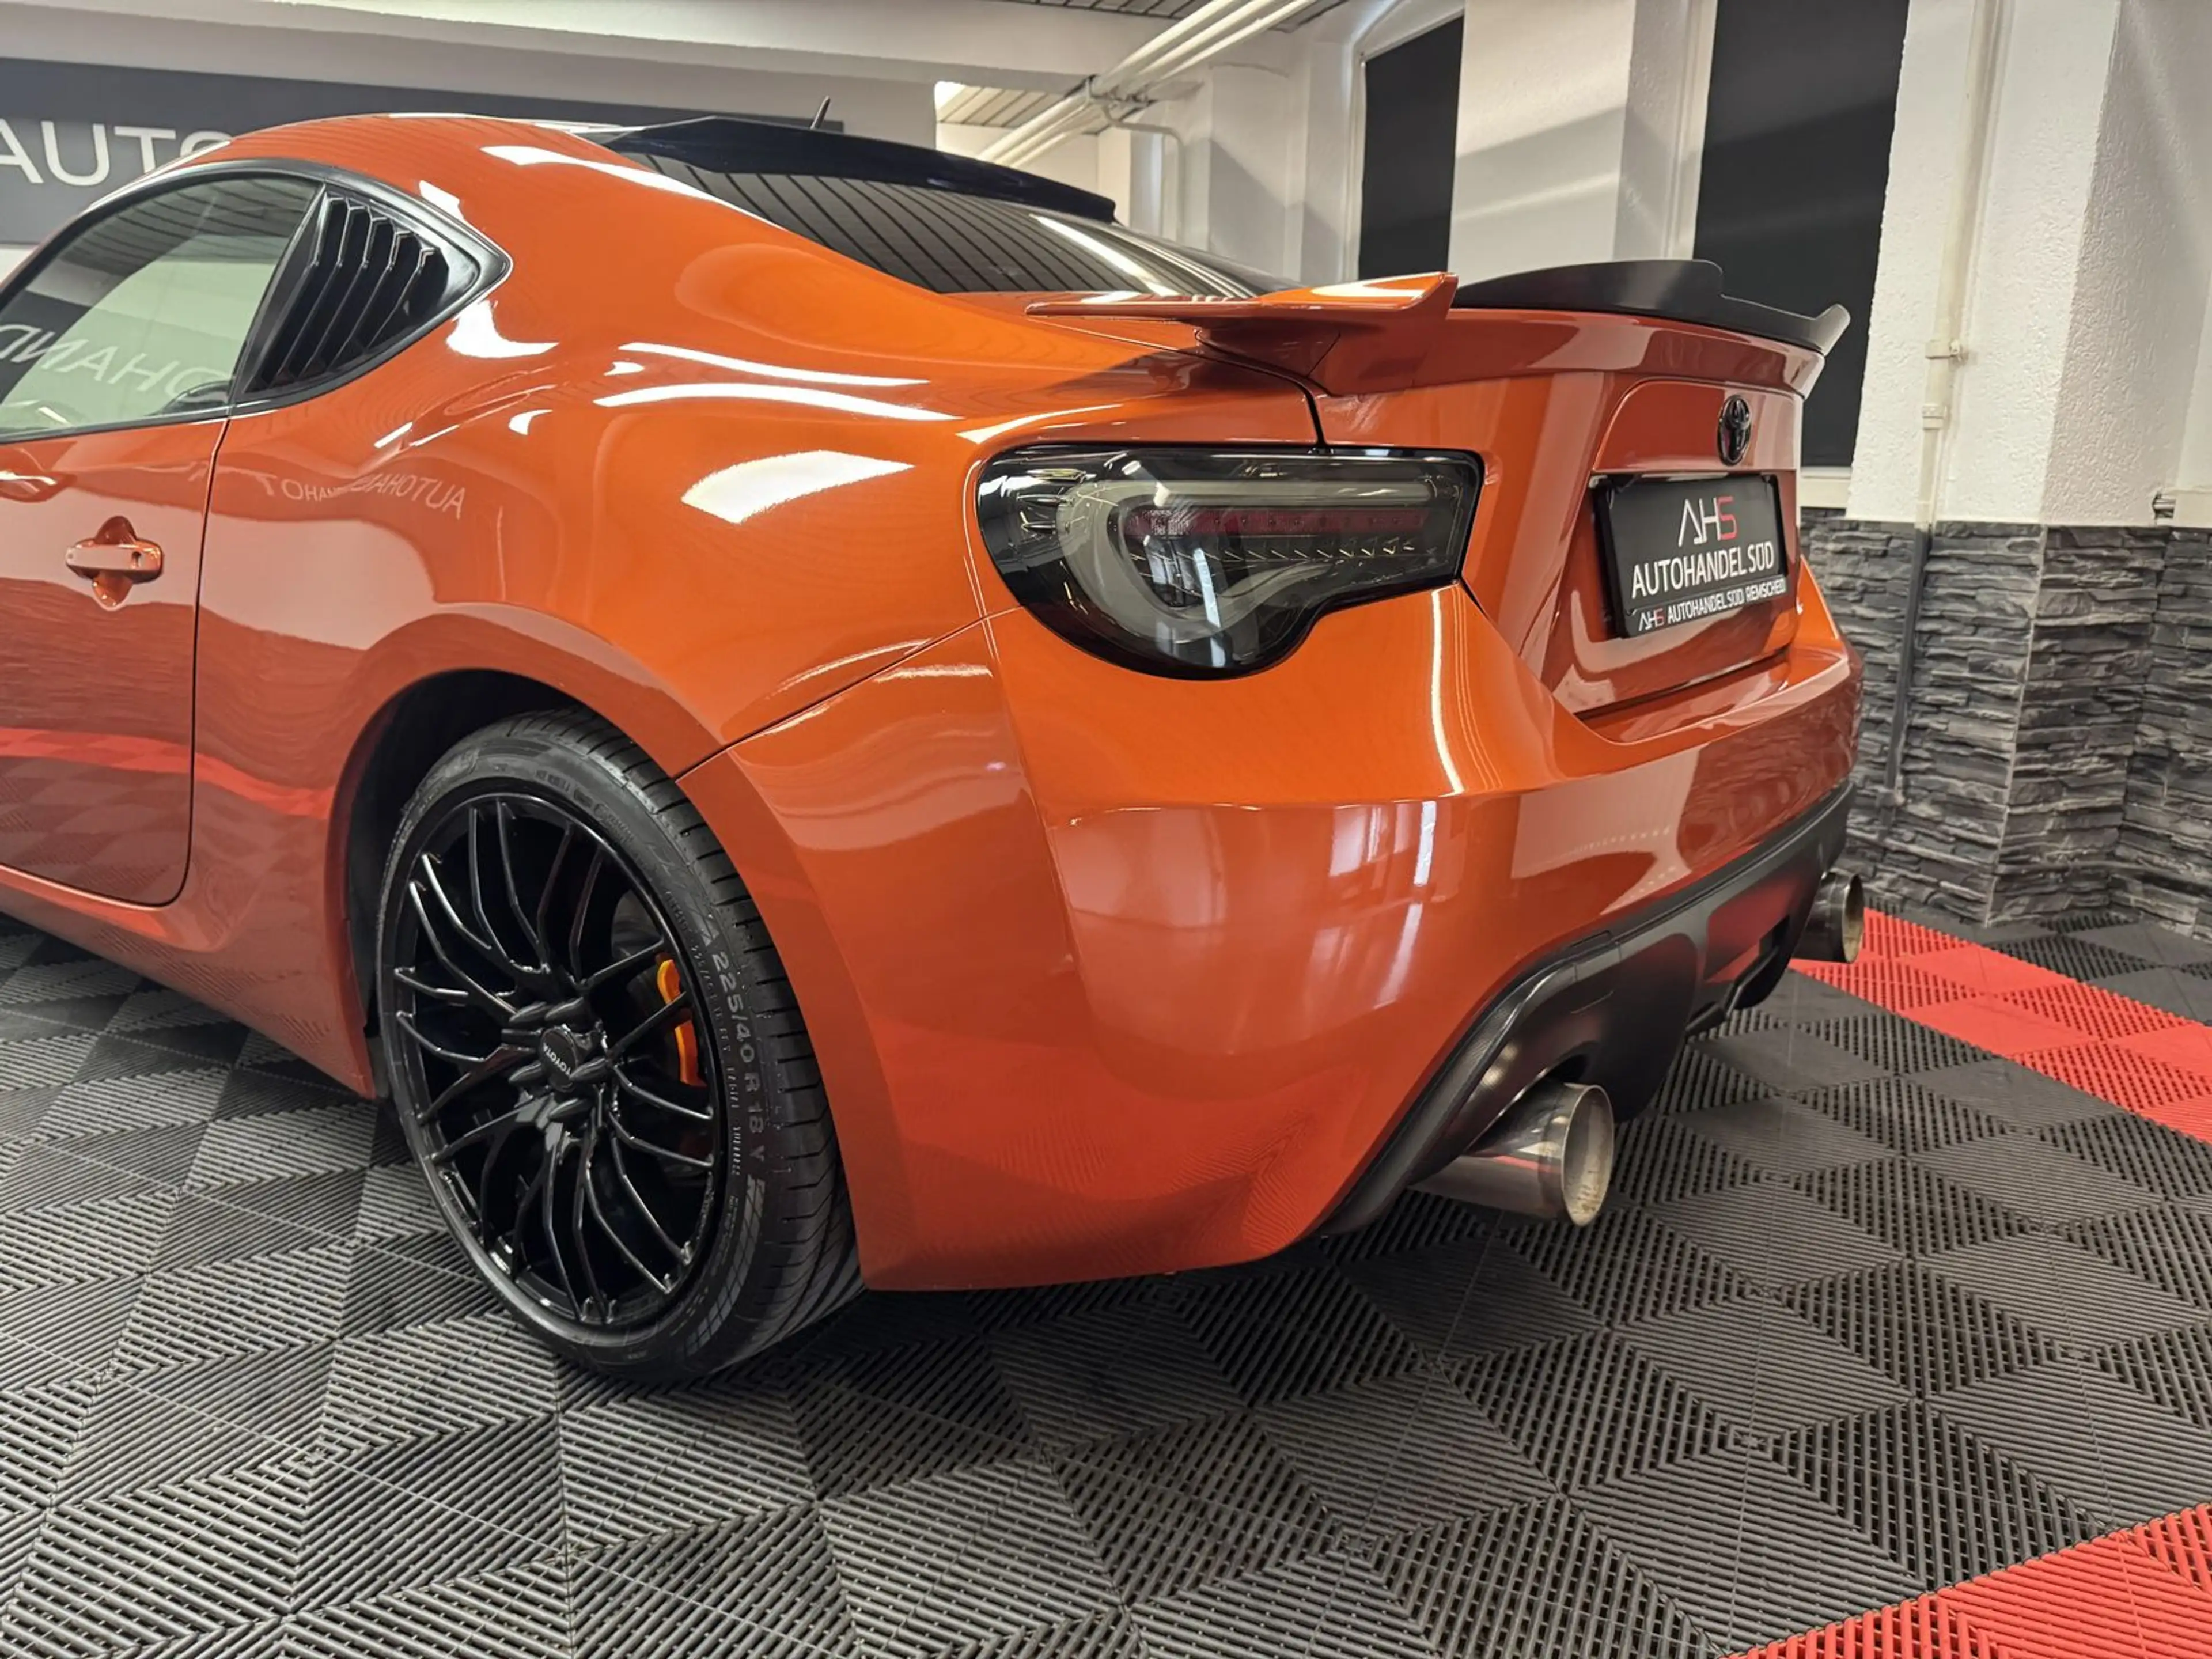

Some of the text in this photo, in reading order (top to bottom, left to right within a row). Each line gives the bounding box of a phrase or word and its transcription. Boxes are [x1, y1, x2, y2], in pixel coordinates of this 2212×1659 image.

[1631, 547, 1747, 599] AUTOHANDEL
[1667, 593, 1728, 624] AUTOHANDEL
[712, 951, 755, 1063] 225/40
[543, 1043, 571, 1077] TOYOTA
